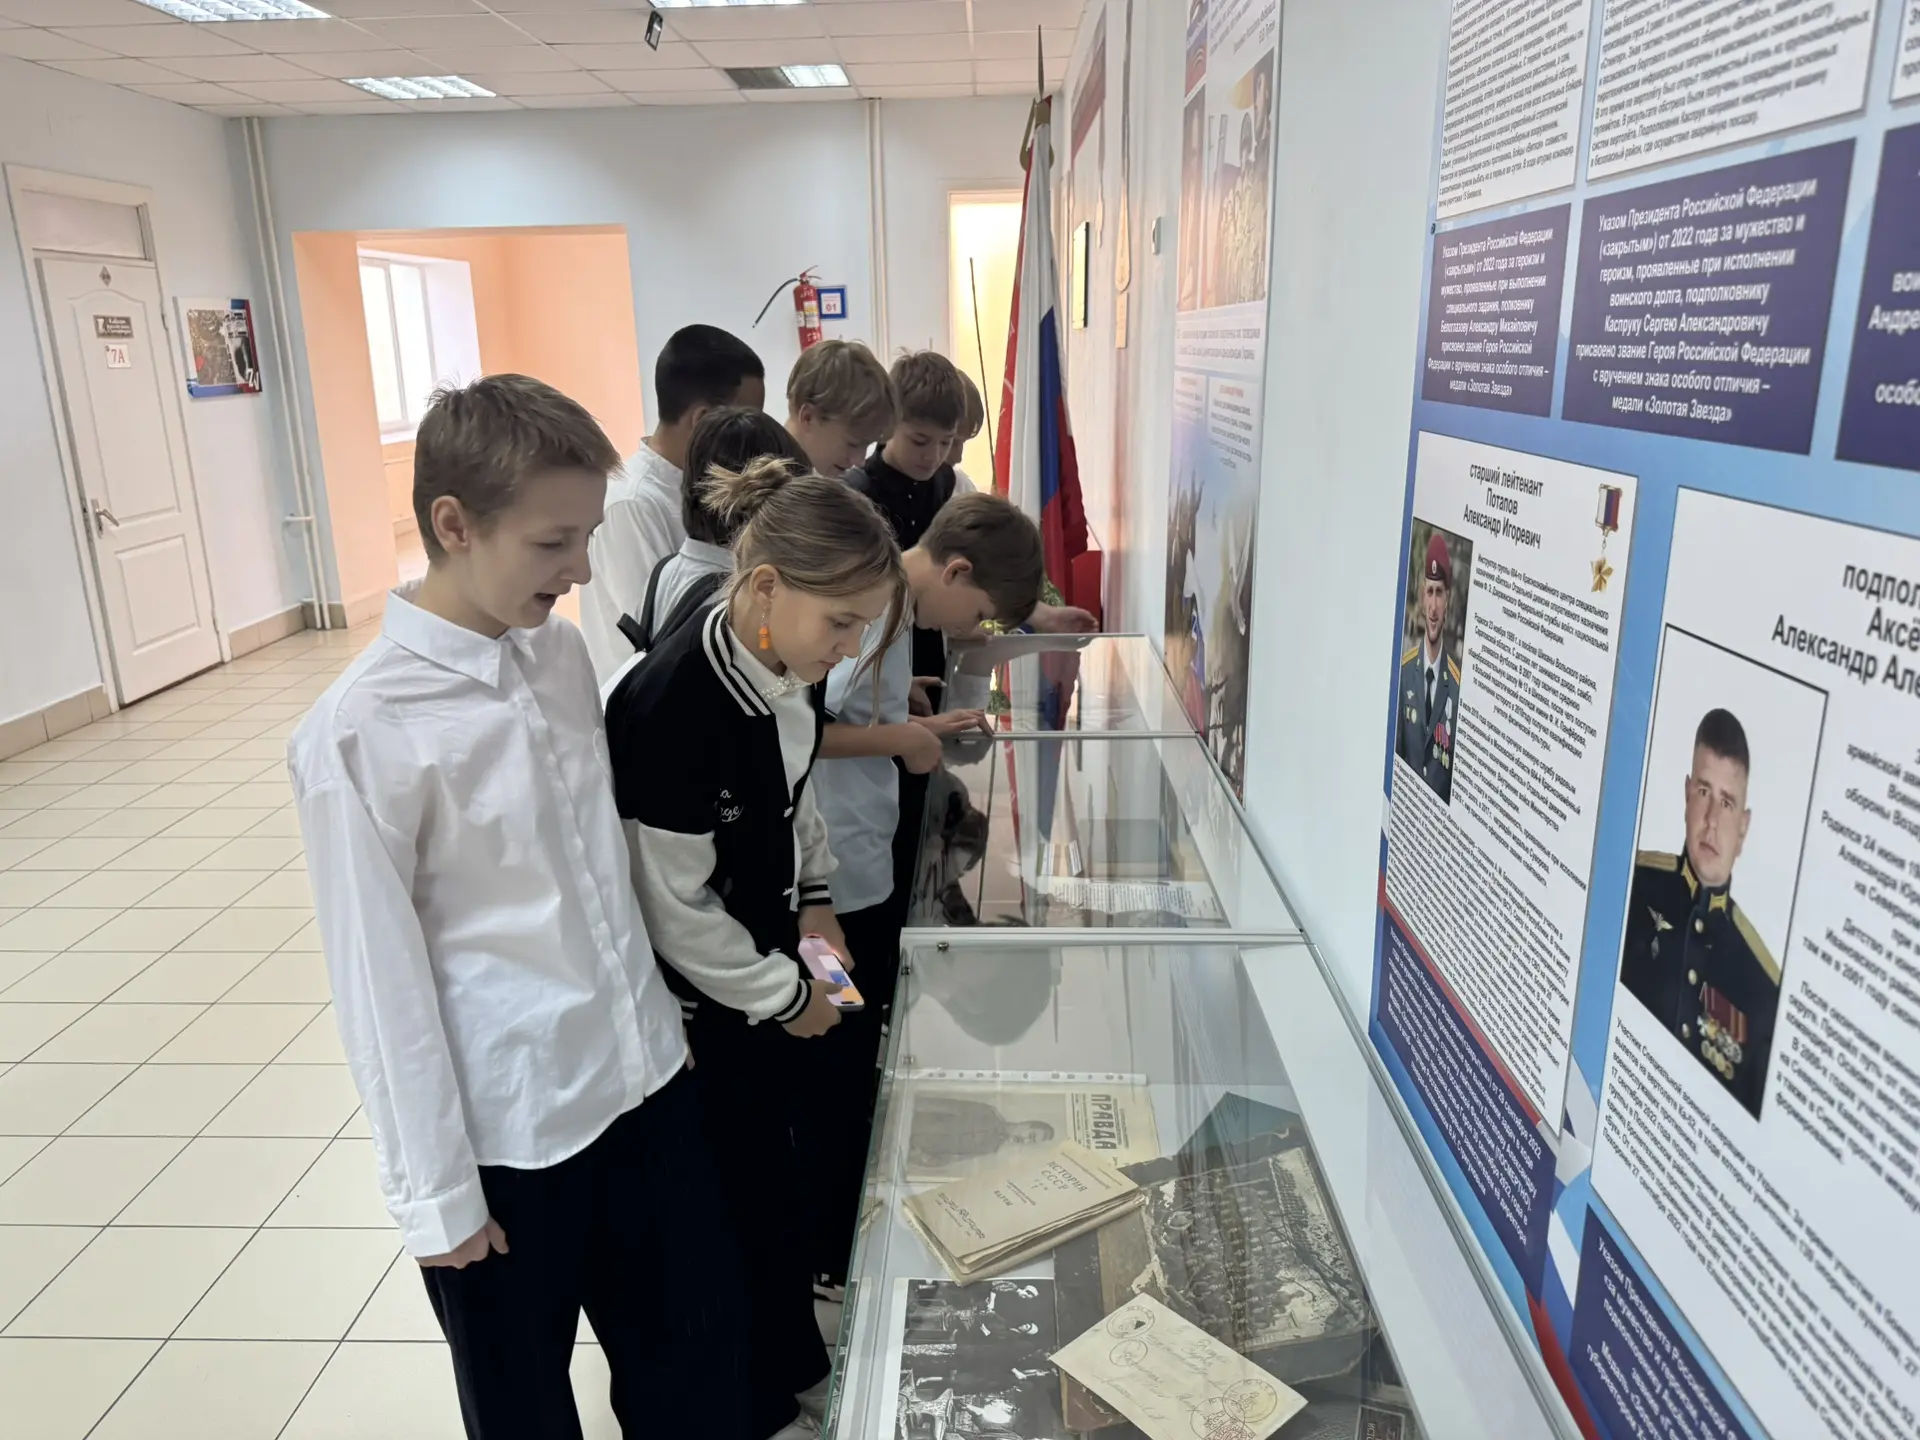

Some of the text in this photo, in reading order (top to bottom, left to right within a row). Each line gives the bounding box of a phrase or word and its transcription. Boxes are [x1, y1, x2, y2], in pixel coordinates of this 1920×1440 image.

[1598, 178, 1817, 232] Указом Президента Российской Федерации
[1442, 228, 1553, 257] Указом Президента Российской Федерации
[1598, 215, 1805, 261] («закрытым») от 2022 года за мужество и
[1476, 261, 1482, 271] от
[1482, 256, 1494, 271] 2022
[1495, 258, 1507, 272] года
[1508, 257, 1514, 267] за
[1515, 253, 1539, 269] героизм
[1540, 252, 1544, 263] и
[1599, 249, 1795, 284] героизм, проявленные при исполнении
[1440, 275, 1546, 298] мужество, проявленные при выполнении
[1609, 284, 1769, 308] воинского долга, подполковнику
[1445, 299, 1533, 315] специального задания, полковнику
[1469, 319, 1498, 335] Александру
[1499, 318, 1537, 335] Михайловичу
[1604, 313, 1769, 336] Каспруку Сергею Александровичу
[1441, 339, 1532, 355] присвоено звание Героя Российской
[1575, 342, 1810, 368] присвоено звание Героя Российской Федерации
[1427, 357, 1450, 372] Федерации
[1451, 361, 1454, 369] с
[1454, 361, 1480, 373] вручением
[1481, 362, 1494, 372] знака
[1495, 361, 1517, 374] особого
[1518, 364, 1543, 376] отличия
[1449, 379, 1512, 397] медали «Золотая Звезда»
[1592, 370, 1597, 381] с
[1599, 371, 1642, 386] вручением
[1644, 373, 1669, 386] знака
[1670, 370, 1711, 389] особого
[1713, 377, 1760, 393] отличия
[1611, 396, 1732, 424] медали «Золотая Звезда»
[1469, 463, 1543, 497] старший лейтенант
[1485, 487, 1518, 515] Потапов
[1463, 502, 1541, 549] Александр Игоревич
[1771, 613, 1878, 685] Александр
[1820, 809, 1862, 845] Родился
[1863, 834, 1876, 853] 24
[1091, 1094, 1117, 1149] ПРАВДА
[1041, 1170, 1069, 1190] СССР
[1047, 1161, 1088, 1192] ИСТОРИЯ
[1598, 1236, 1623, 1285] Указом
[1624, 1274, 1670, 1354] Президента
